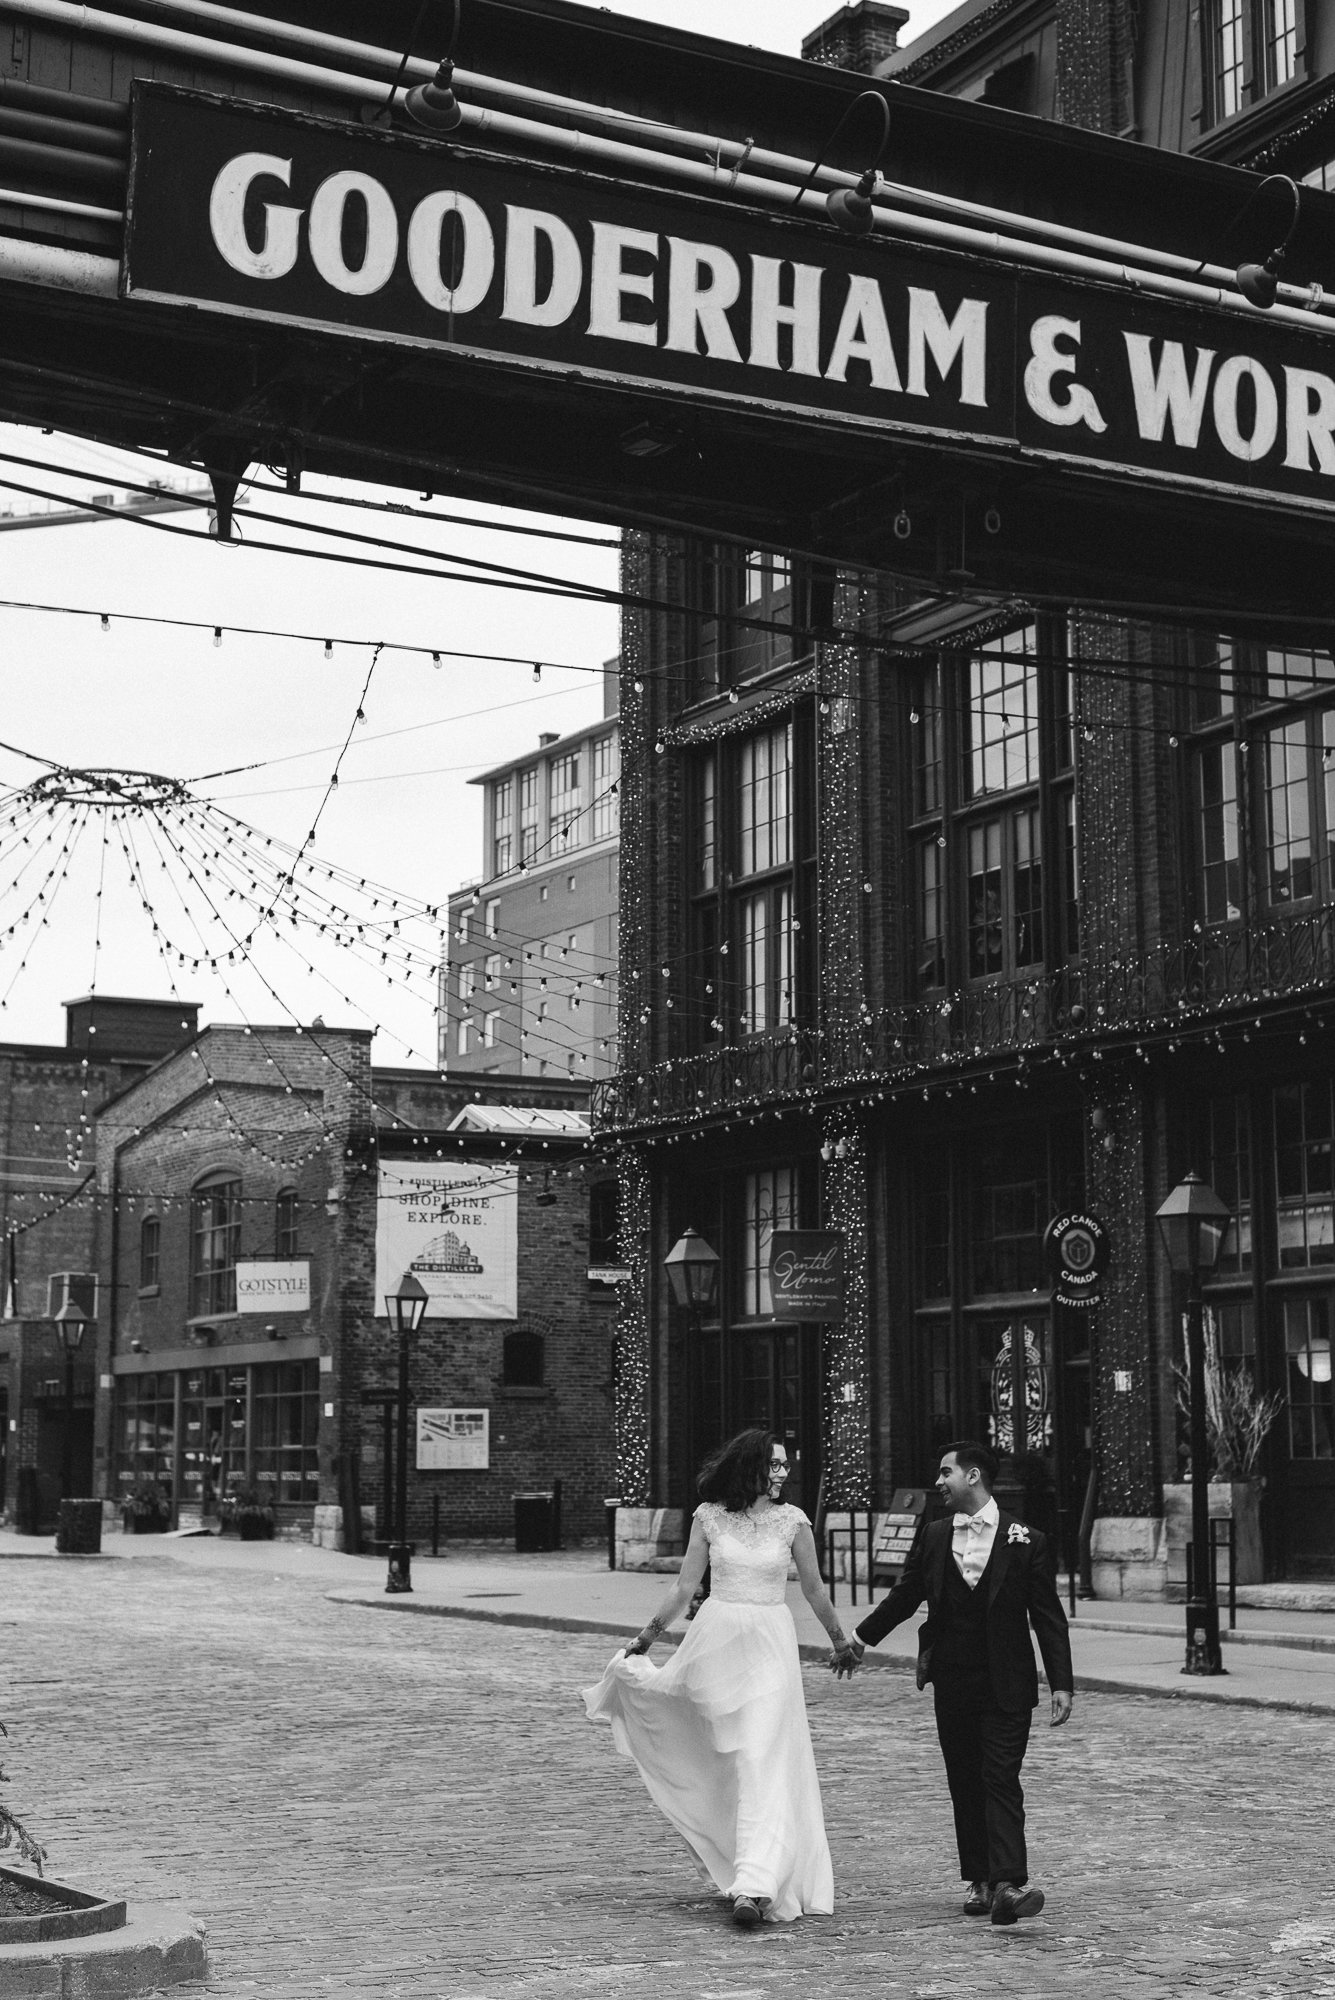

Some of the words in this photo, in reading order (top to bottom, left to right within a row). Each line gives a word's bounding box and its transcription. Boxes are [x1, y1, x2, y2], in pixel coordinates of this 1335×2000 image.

[209, 152, 991, 408] GOODERHAM
[1023, 315, 1109, 433] &
[451, 1197, 495, 1209] DINE.
[408, 1211, 487, 1225] EXPLORE.
[1052, 1218, 1070, 1238] RED
[1071, 1214, 1103, 1238] CANOE
[413, 1263, 430, 1271] THE
[432, 1264, 480, 1272] DISTILLERY
[773, 1246, 838, 1277] Gentil
[1060, 1270, 1099, 1284] CANADA
[238, 1278, 308, 1292] GOTSTYLE
[1056, 1294, 1101, 1307] OUTFITTER
